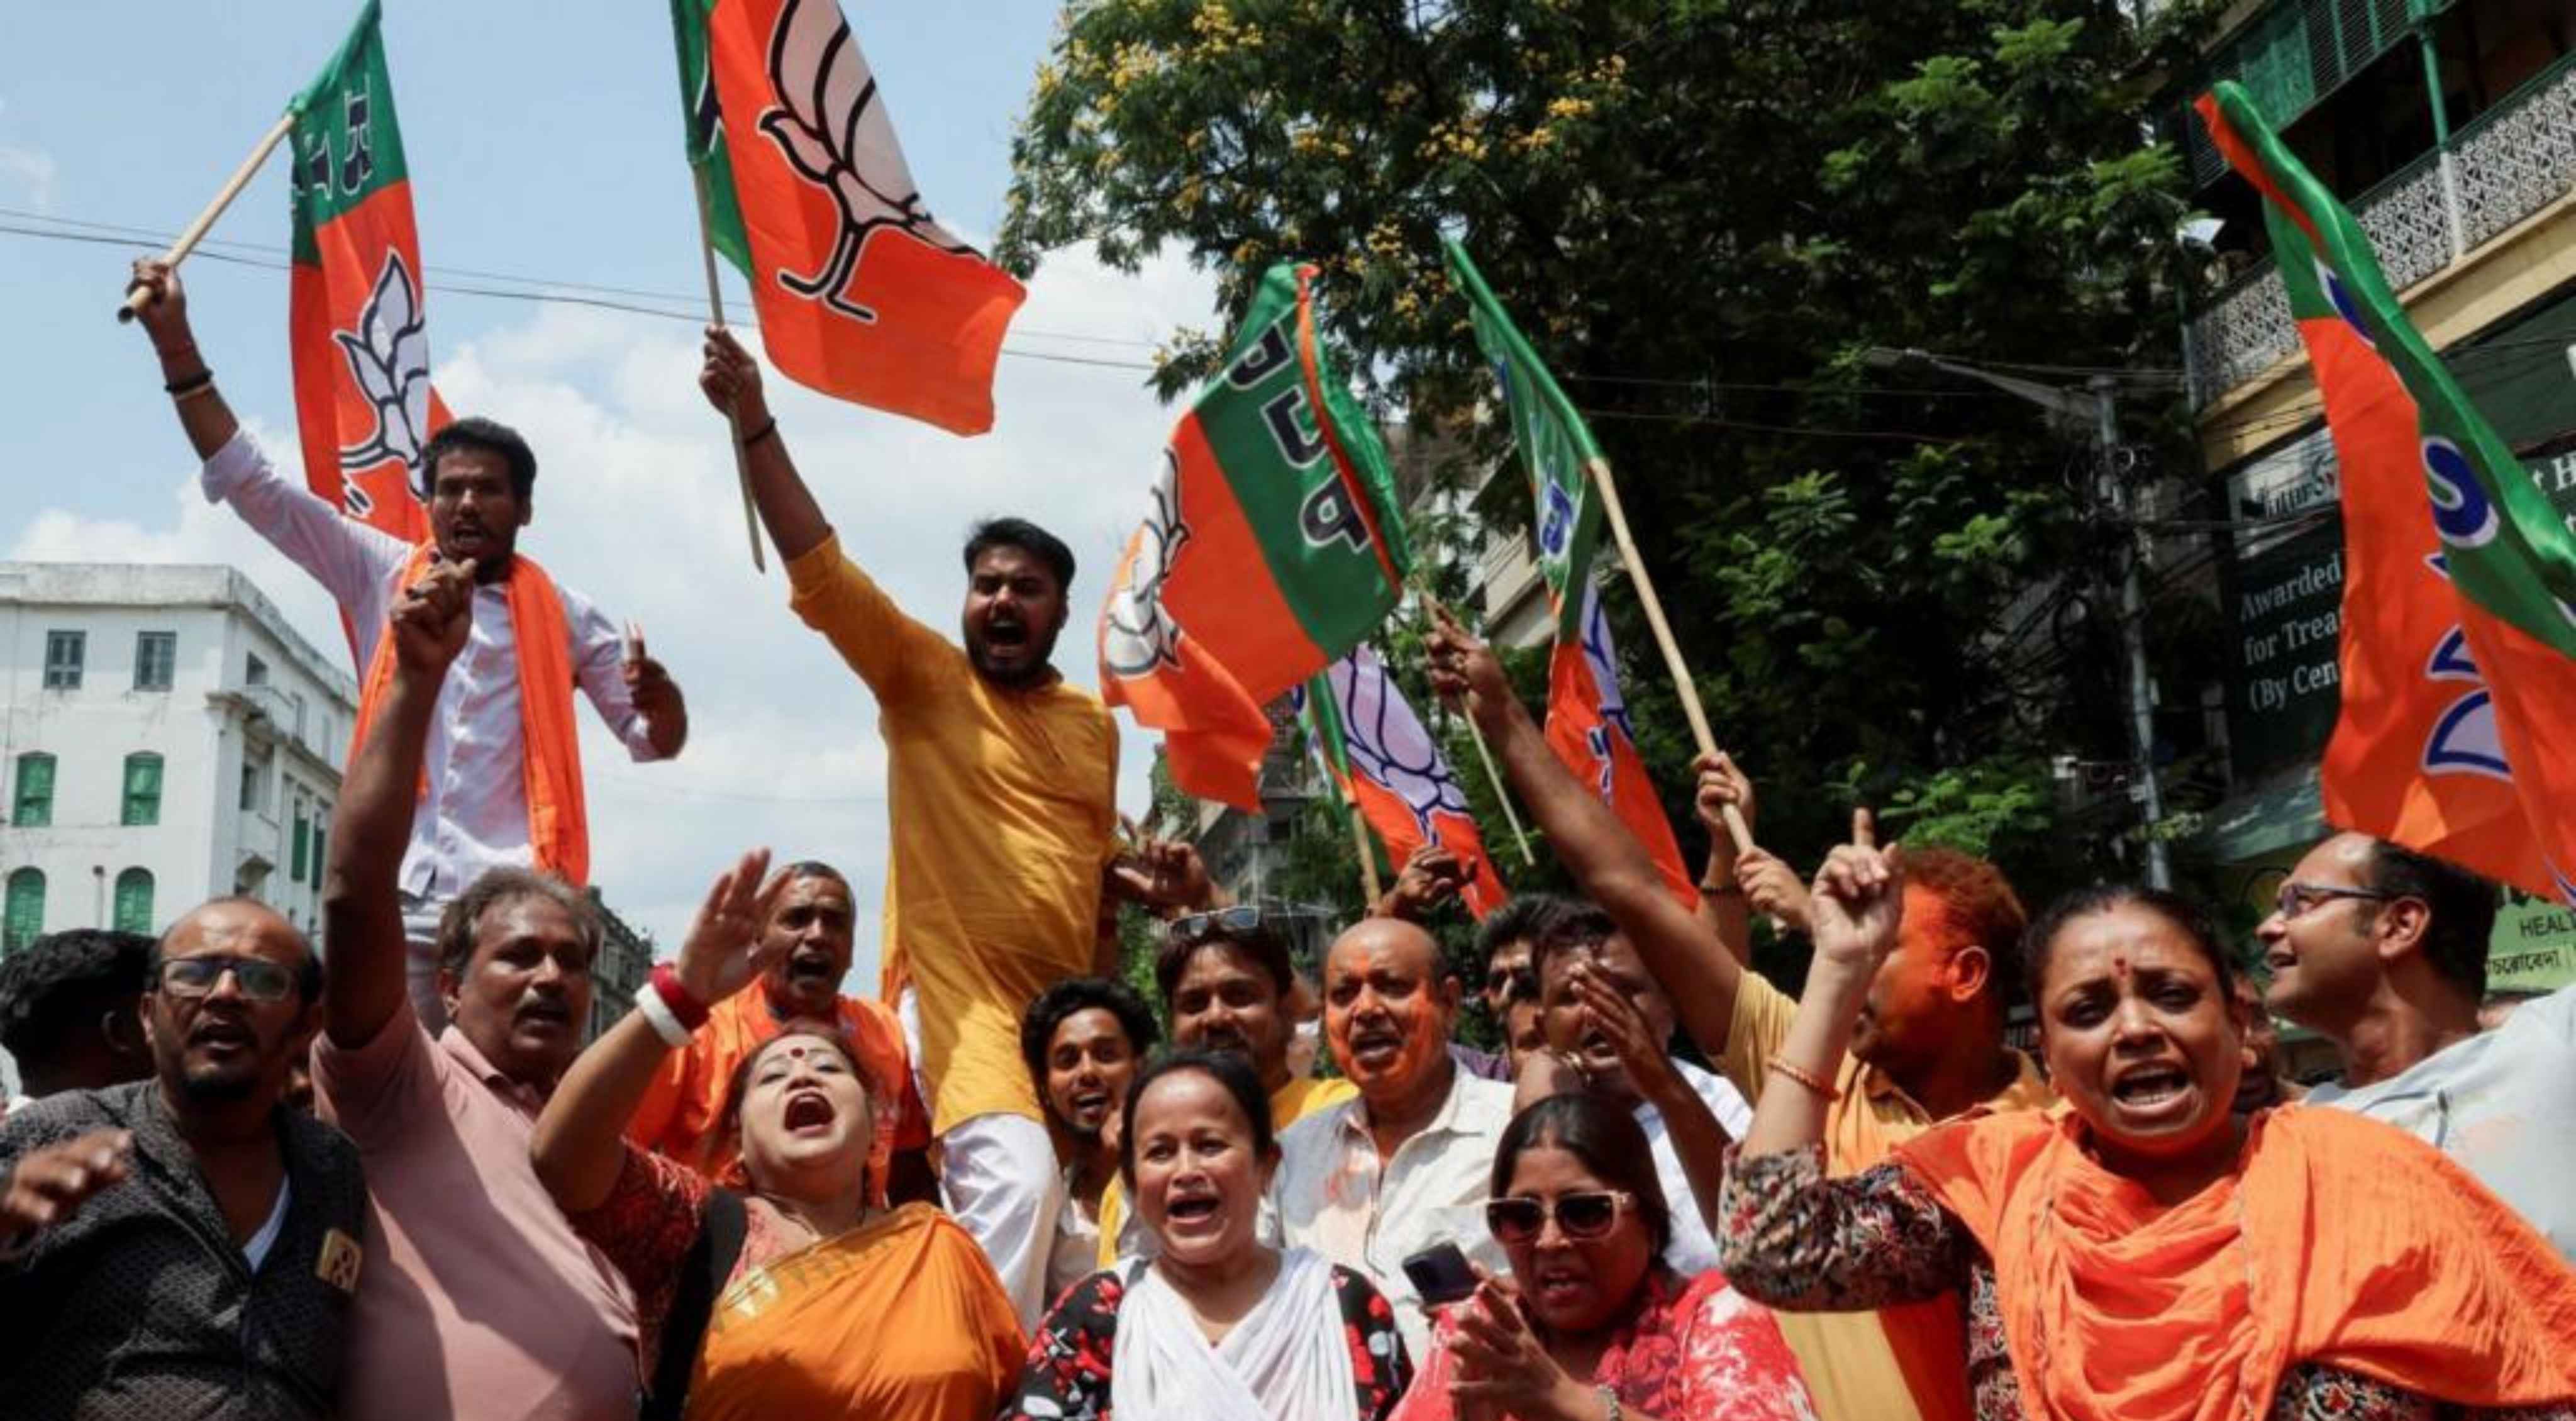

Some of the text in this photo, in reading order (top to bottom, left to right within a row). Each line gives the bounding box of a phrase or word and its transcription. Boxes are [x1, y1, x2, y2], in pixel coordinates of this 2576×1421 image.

[2241, 553, 2341, 623] Awarded
[2245, 611, 2339, 665] for Trea
[2250, 676, 2288, 712] (By
